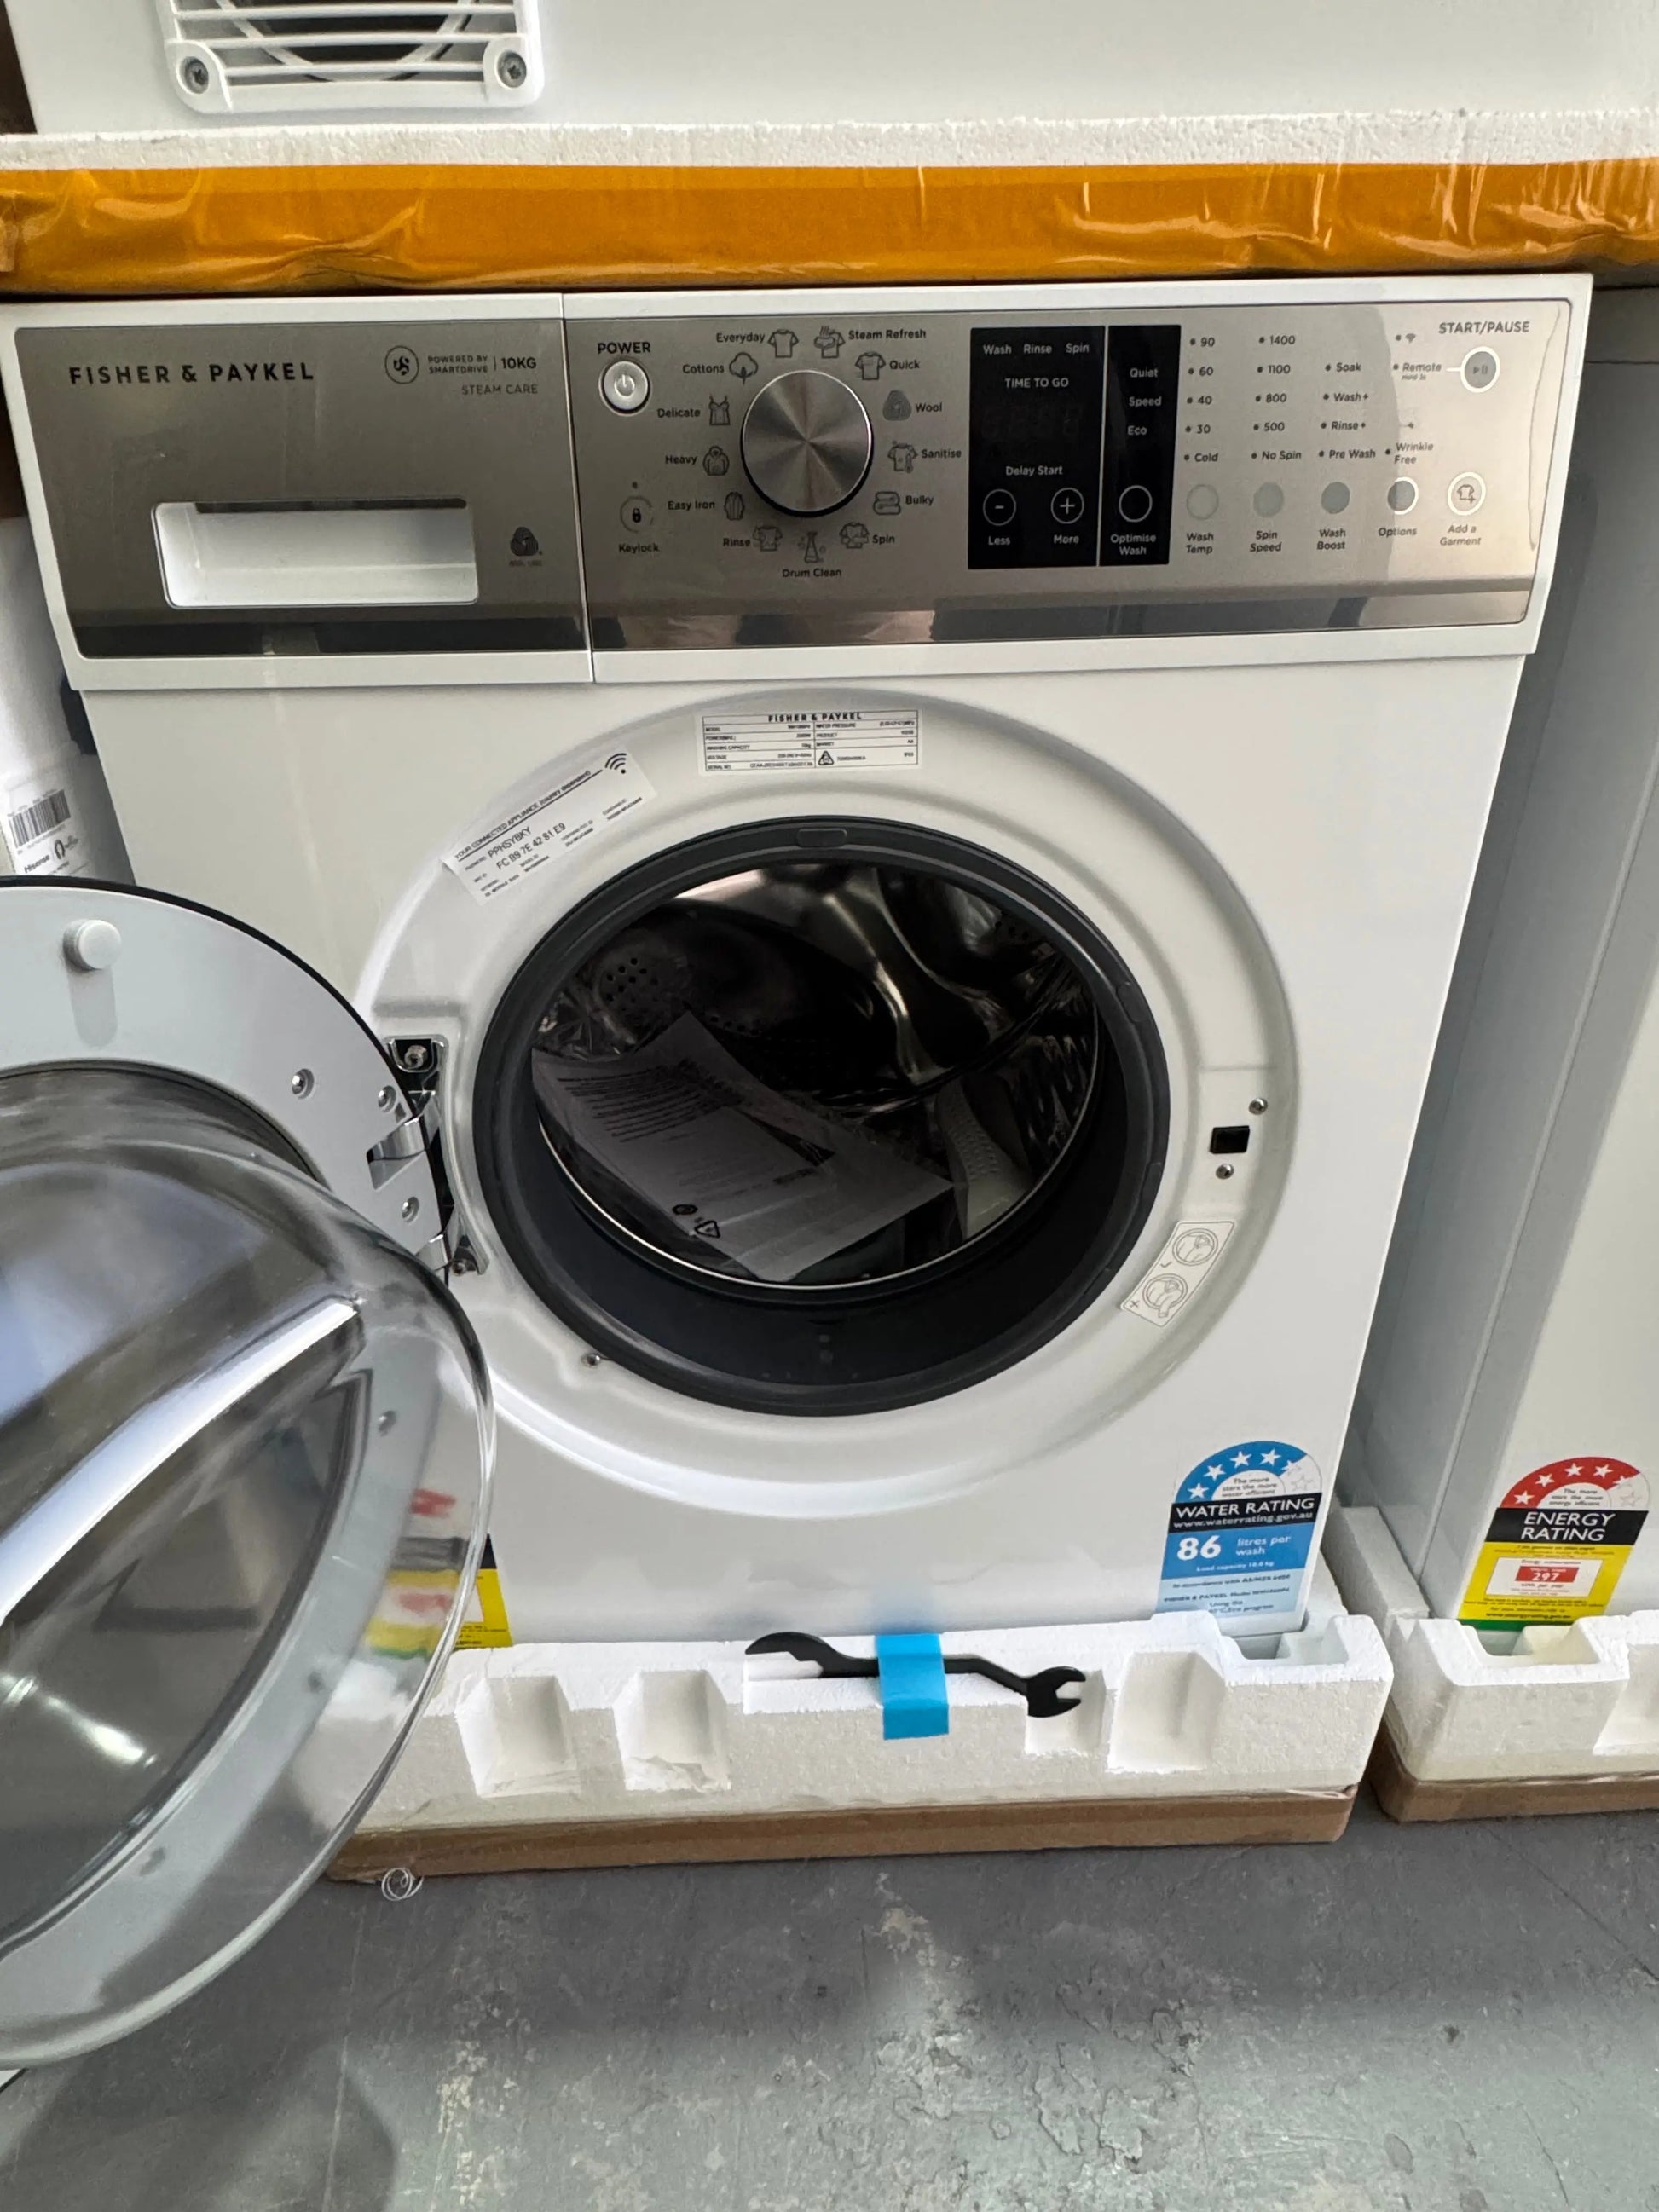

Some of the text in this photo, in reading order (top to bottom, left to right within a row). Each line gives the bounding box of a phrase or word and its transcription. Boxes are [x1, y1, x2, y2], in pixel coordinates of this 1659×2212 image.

[1439, 321, 1529, 334] START/PAUSE
[716, 332, 766, 344] Everyday
[849, 329, 926, 339] Steam Refresh
[1200, 338, 1215, 346] 90
[1269, 336, 1295, 344] 1400
[598, 342, 650, 354] POWER
[983, 344, 1011, 355] Wash
[1024, 344, 1052, 354] Rinse
[1066, 343, 1089, 355] Spin
[501, 357, 536, 369] 10KG
[890, 361, 920, 369] Quick
[1337, 363, 1361, 373] Soak
[1402, 362, 1442, 373] Remote
[69, 363, 314, 384] FISHER & PAYKEL
[683, 365, 724, 373] Cottons
[1130, 367, 1159, 378] Quiet
[1199, 367, 1213, 376] 60
[1268, 365, 1291, 374] 1100
[1005, 378, 1069, 388] TIME TO GO
[462, 384, 538, 396] STEAM CARE
[1129, 396, 1161, 407] Speed
[1198, 396, 1212, 405] 40
[1266, 394, 1287, 402] 800
[916, 402, 942, 413] Wool
[657, 408, 700, 418] Delicate
[1127, 425, 1147, 435] Eco
[1197, 425, 1211, 434] 30
[1264, 423, 1285, 431] 500
[1396, 442, 1434, 451] Wrinkle
[922, 449, 962, 459] Sanitise
[1194, 453, 1218, 462] Cold
[1262, 451, 1301, 461] No Spin
[1329, 448, 1376, 459] Pre Wash
[665, 456, 697, 465] Heavy
[1395, 455, 1417, 465] Free
[1006, 465, 1062, 476] Delay Start
[905, 495, 934, 505] Bulky
[668, 500, 715, 511] Easy Iron
[1319, 528, 1346, 537] Wash
[1379, 528, 1417, 537] Options
[1448, 524, 1468, 534] Add
[872, 535, 894, 545] Spin
[1054, 534, 1079, 544] More
[1111, 534, 1156, 544] Optimise
[1187, 533, 1214, 541] Wash
[1256, 530, 1277, 540] Spin
[723, 538, 750, 546] Rinse
[988, 536, 1010, 545] Less
[1317, 541, 1345, 550] Boost
[1440, 537, 1481, 546] Garment
[619, 544, 659, 554] Keylock
[1119, 546, 1147, 555] Wash
[1186, 545, 1212, 554] Temp
[1250, 542, 1282, 552] Speed
[813, 568, 841, 577] Clean
[823, 712, 862, 720] PAYKEL
[496, 857, 510, 869] FC
[520, 843, 532, 854] 7E
[531, 835, 543, 847] 42
[552, 822, 565, 834] E9
[1176, 1498, 1315, 1518] WATER RATING
[1174, 1512, 1313, 1528] www.waterrating.gov.au
[1524, 1512, 1616, 1527] ENERGY
[1521, 1528, 1605, 1541] RATING
[1238, 1536, 1291, 1547] litres per
[1177, 1535, 1221, 1561] 86
[1236, 1547, 1265, 1556] wash
